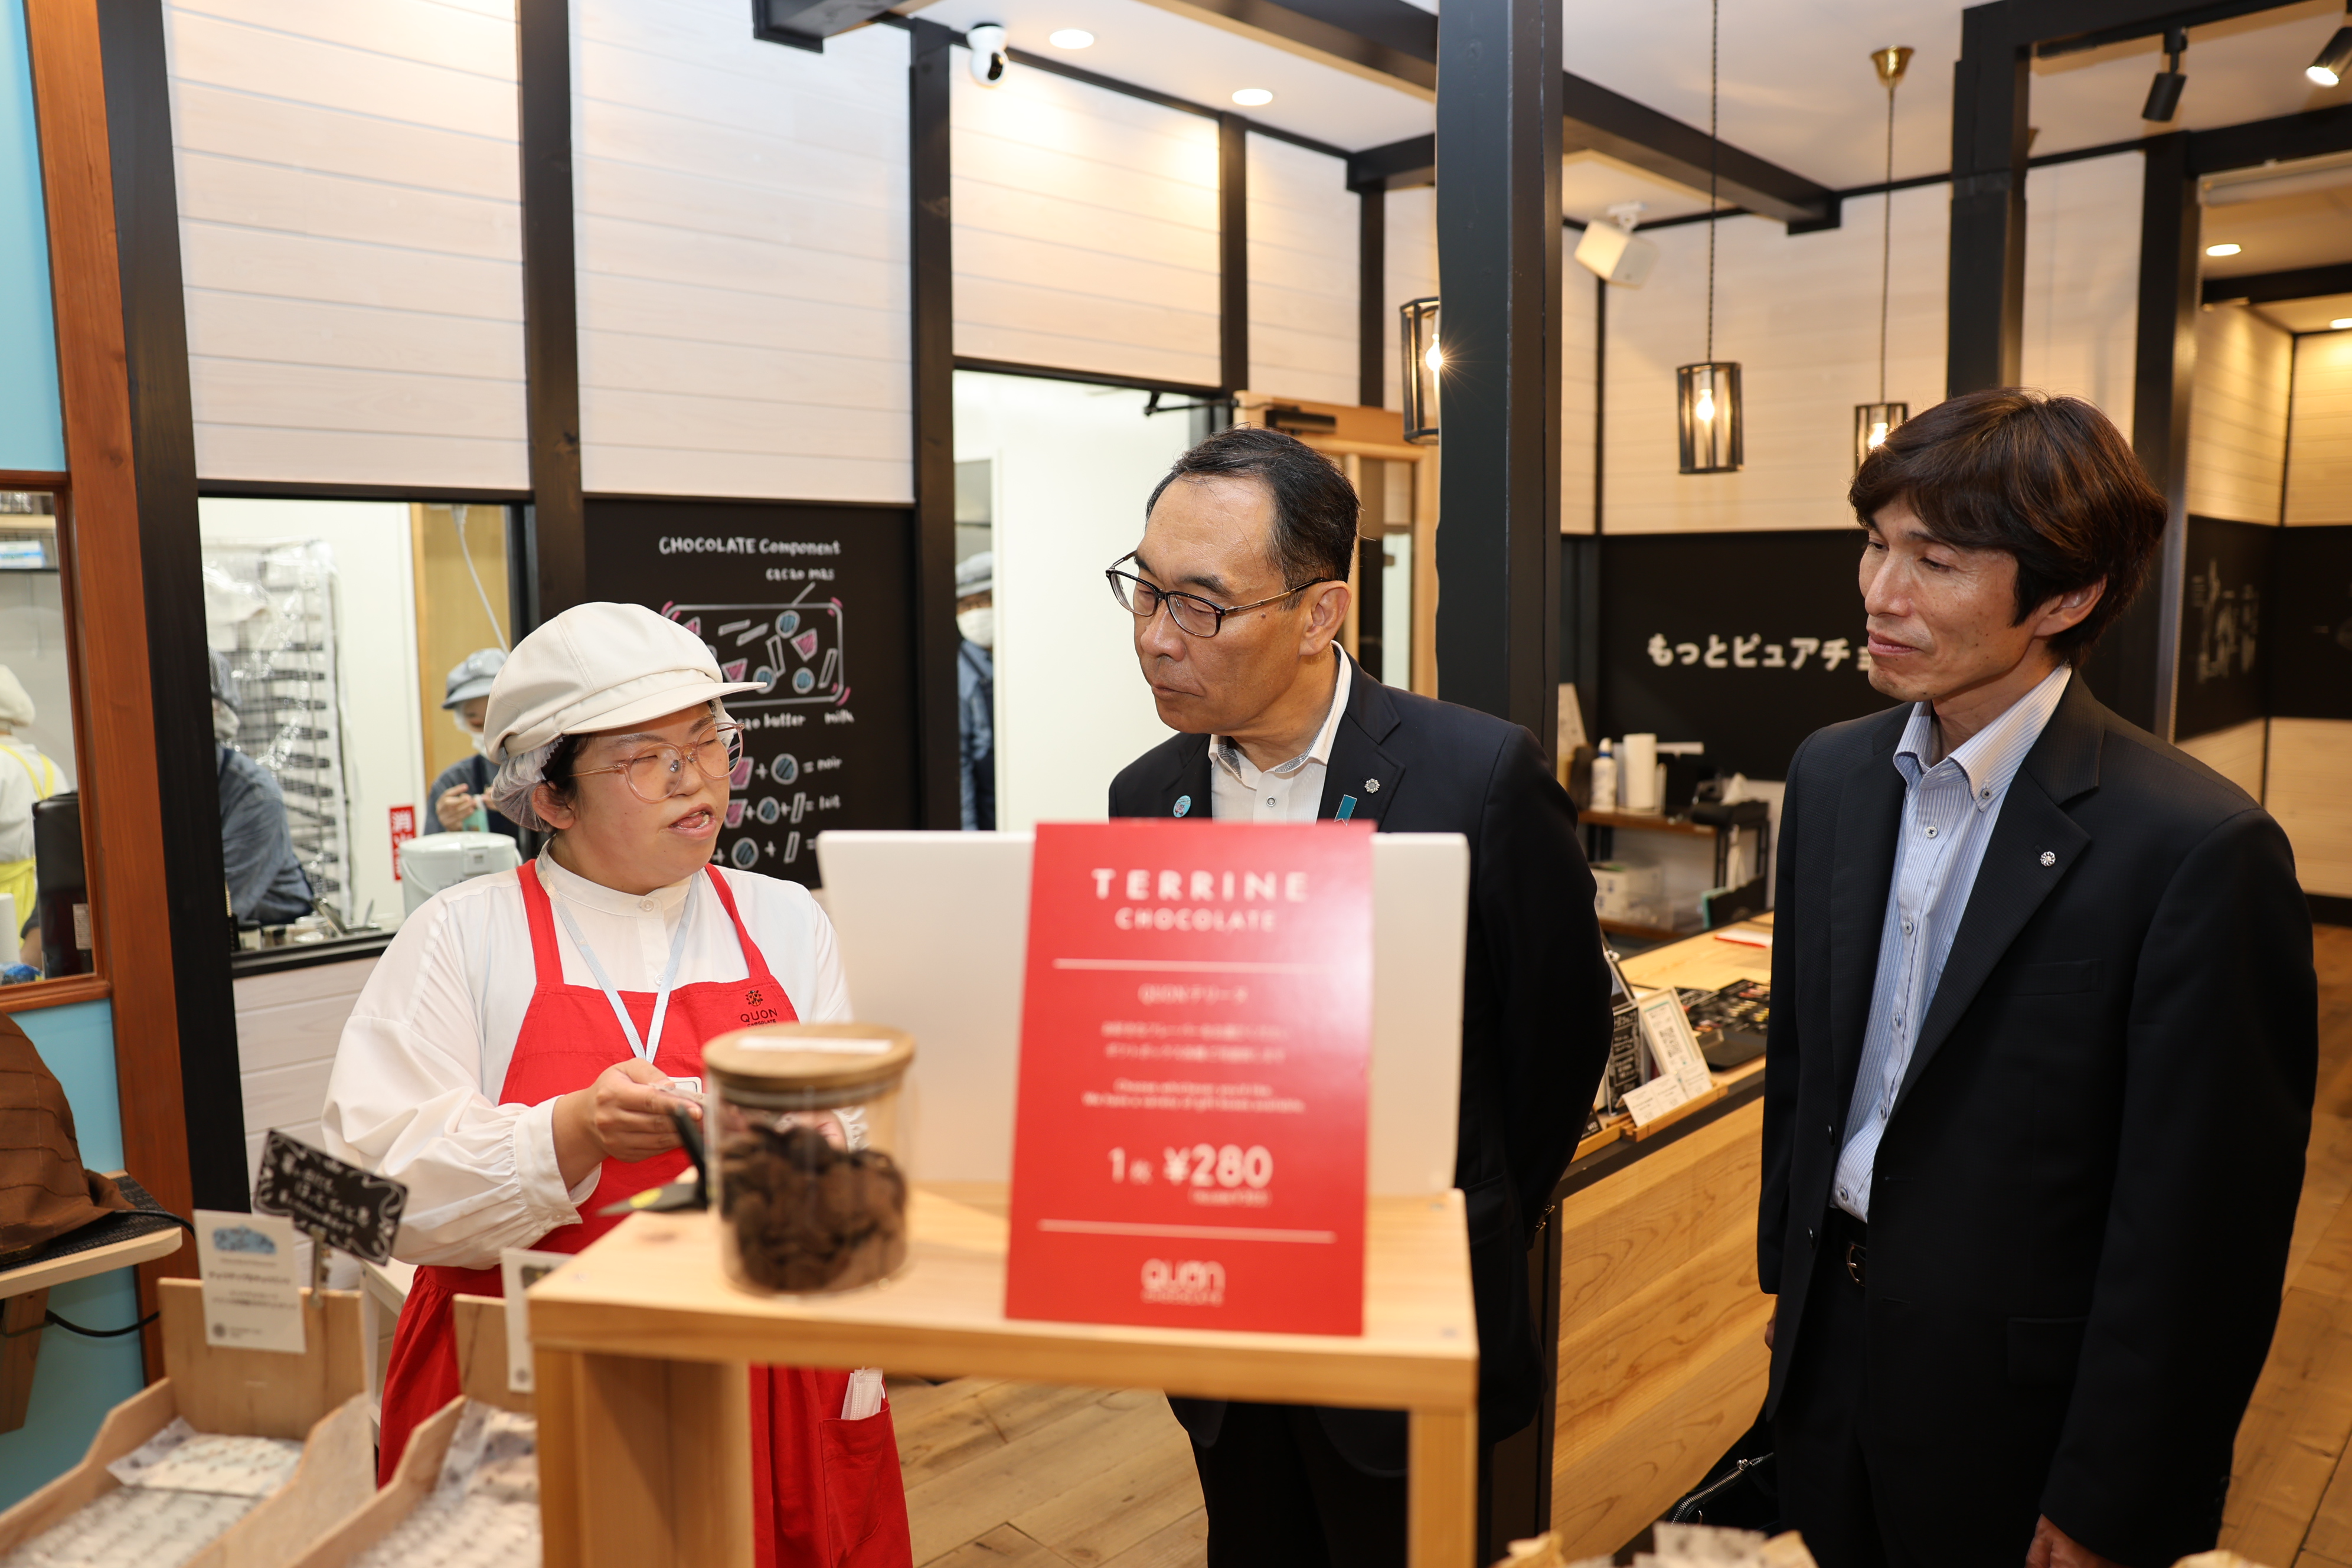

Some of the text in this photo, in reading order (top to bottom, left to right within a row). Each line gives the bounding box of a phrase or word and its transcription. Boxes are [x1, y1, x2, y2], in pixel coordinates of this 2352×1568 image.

[659, 537, 841, 556] CHOCOLATE Component
[1091, 868, 1309, 902] TERRINE
[1115, 907, 1276, 932] CHOCOLATE
[740, 1008, 778, 1023] QUON
[1162, 1143, 1273, 1189] ¥280
